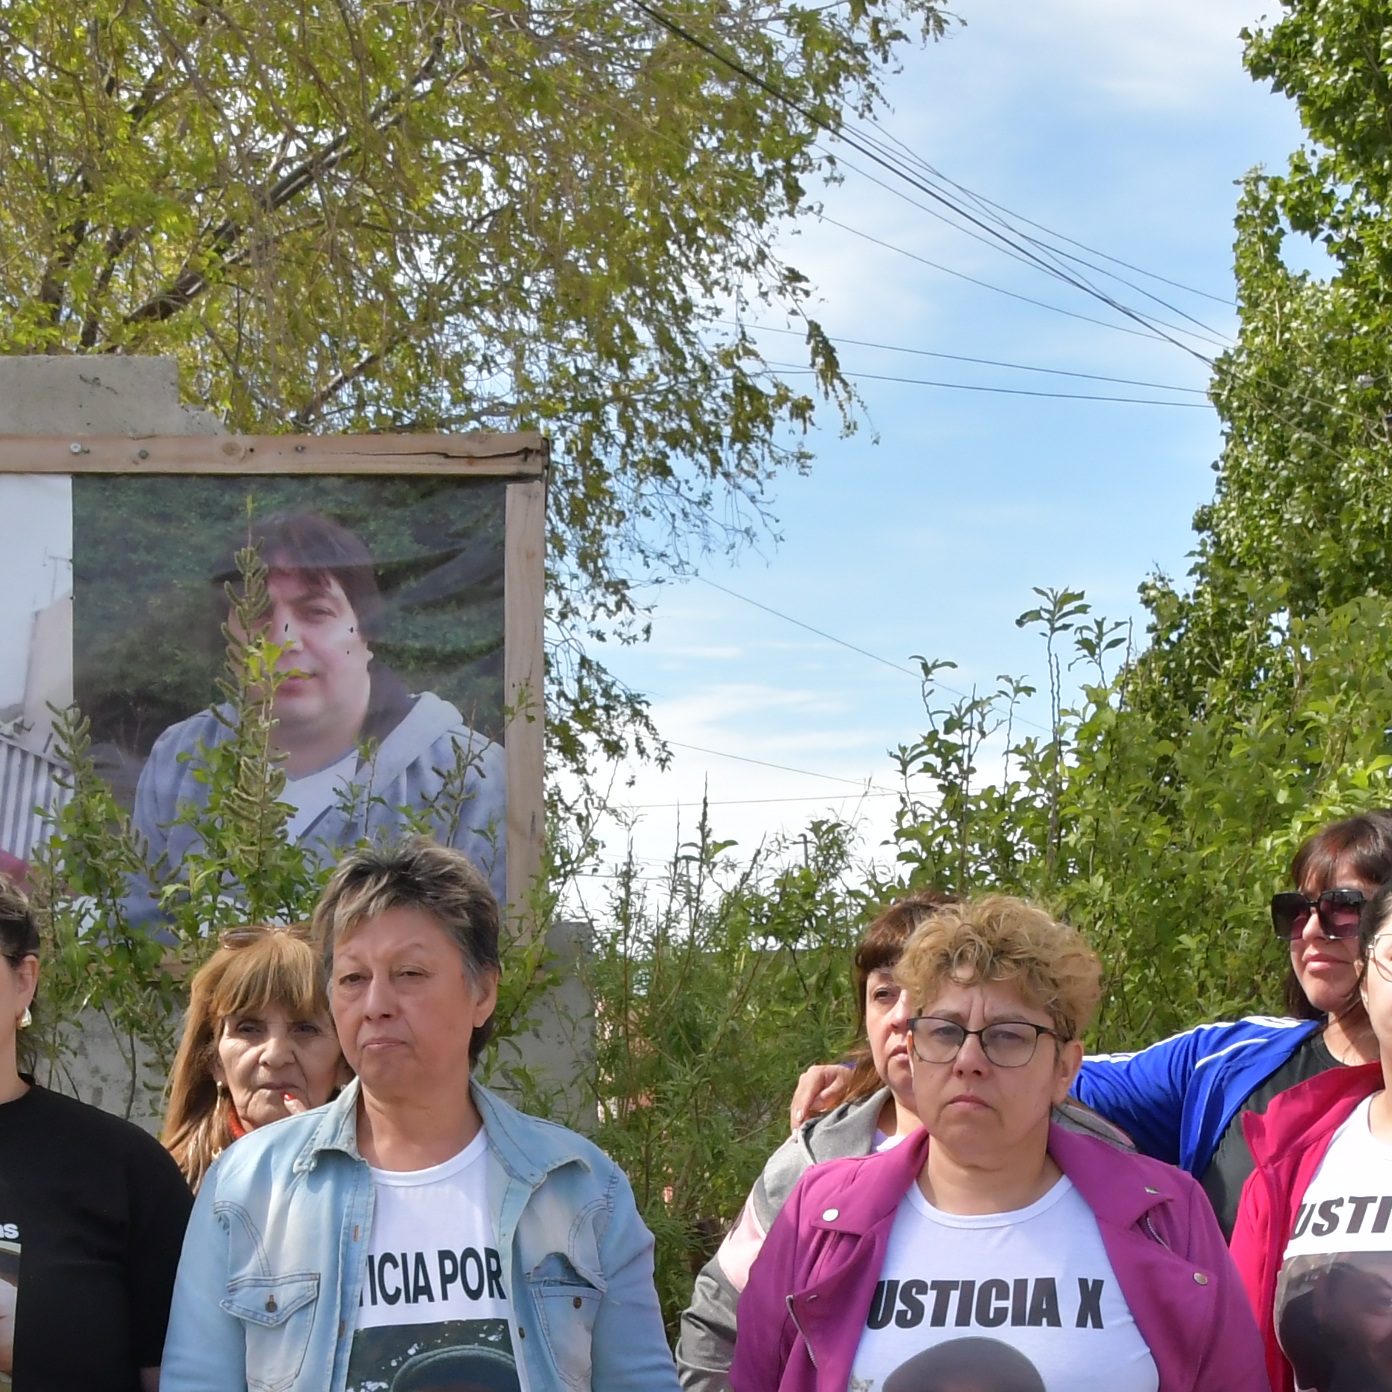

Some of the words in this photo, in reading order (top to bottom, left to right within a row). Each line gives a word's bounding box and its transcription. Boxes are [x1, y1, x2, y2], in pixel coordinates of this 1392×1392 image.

[359, 1251, 435, 1307] ICIA
[437, 1246, 507, 1302] POR
[1075, 1278, 1105, 1330] X
